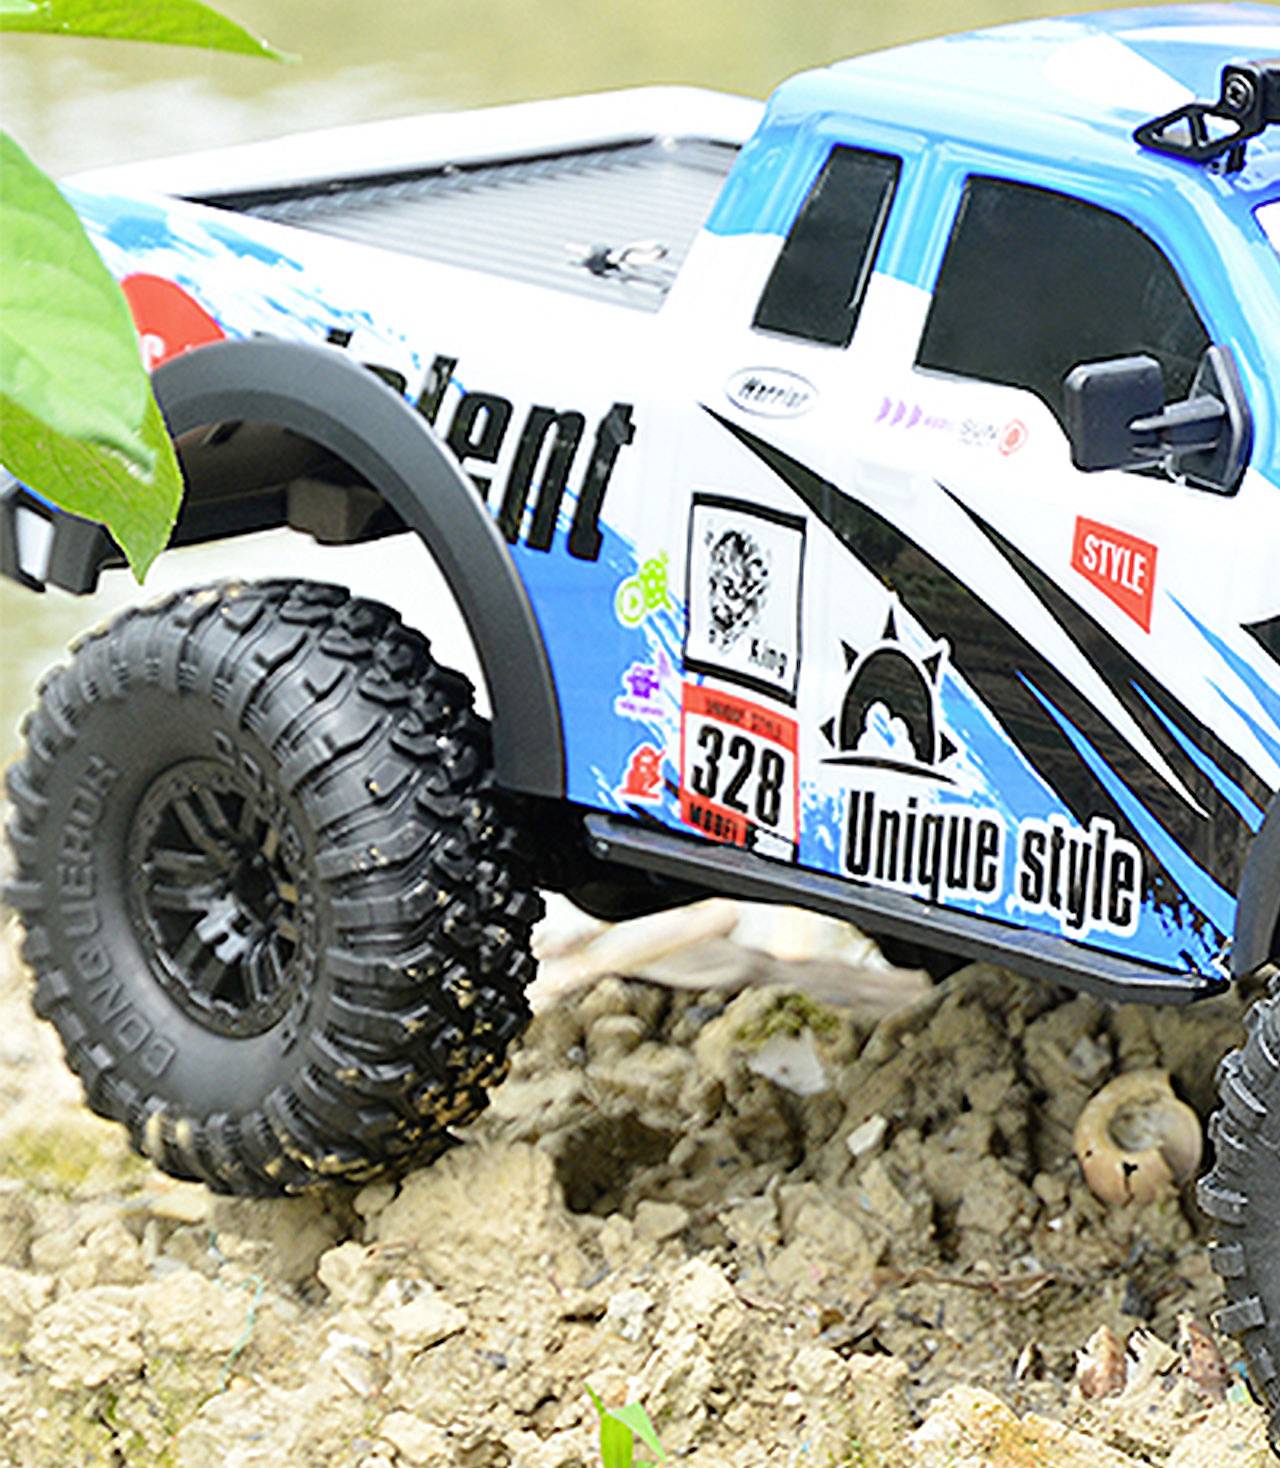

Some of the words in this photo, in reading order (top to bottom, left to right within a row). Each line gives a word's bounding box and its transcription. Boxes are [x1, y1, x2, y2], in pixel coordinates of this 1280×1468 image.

[326, 328, 636, 561] lent
[1083, 534, 1147, 596] STYLE
[690, 724, 786, 828] 328
[846, 790, 999, 901] Unique
[1021, 825, 1135, 929] style
